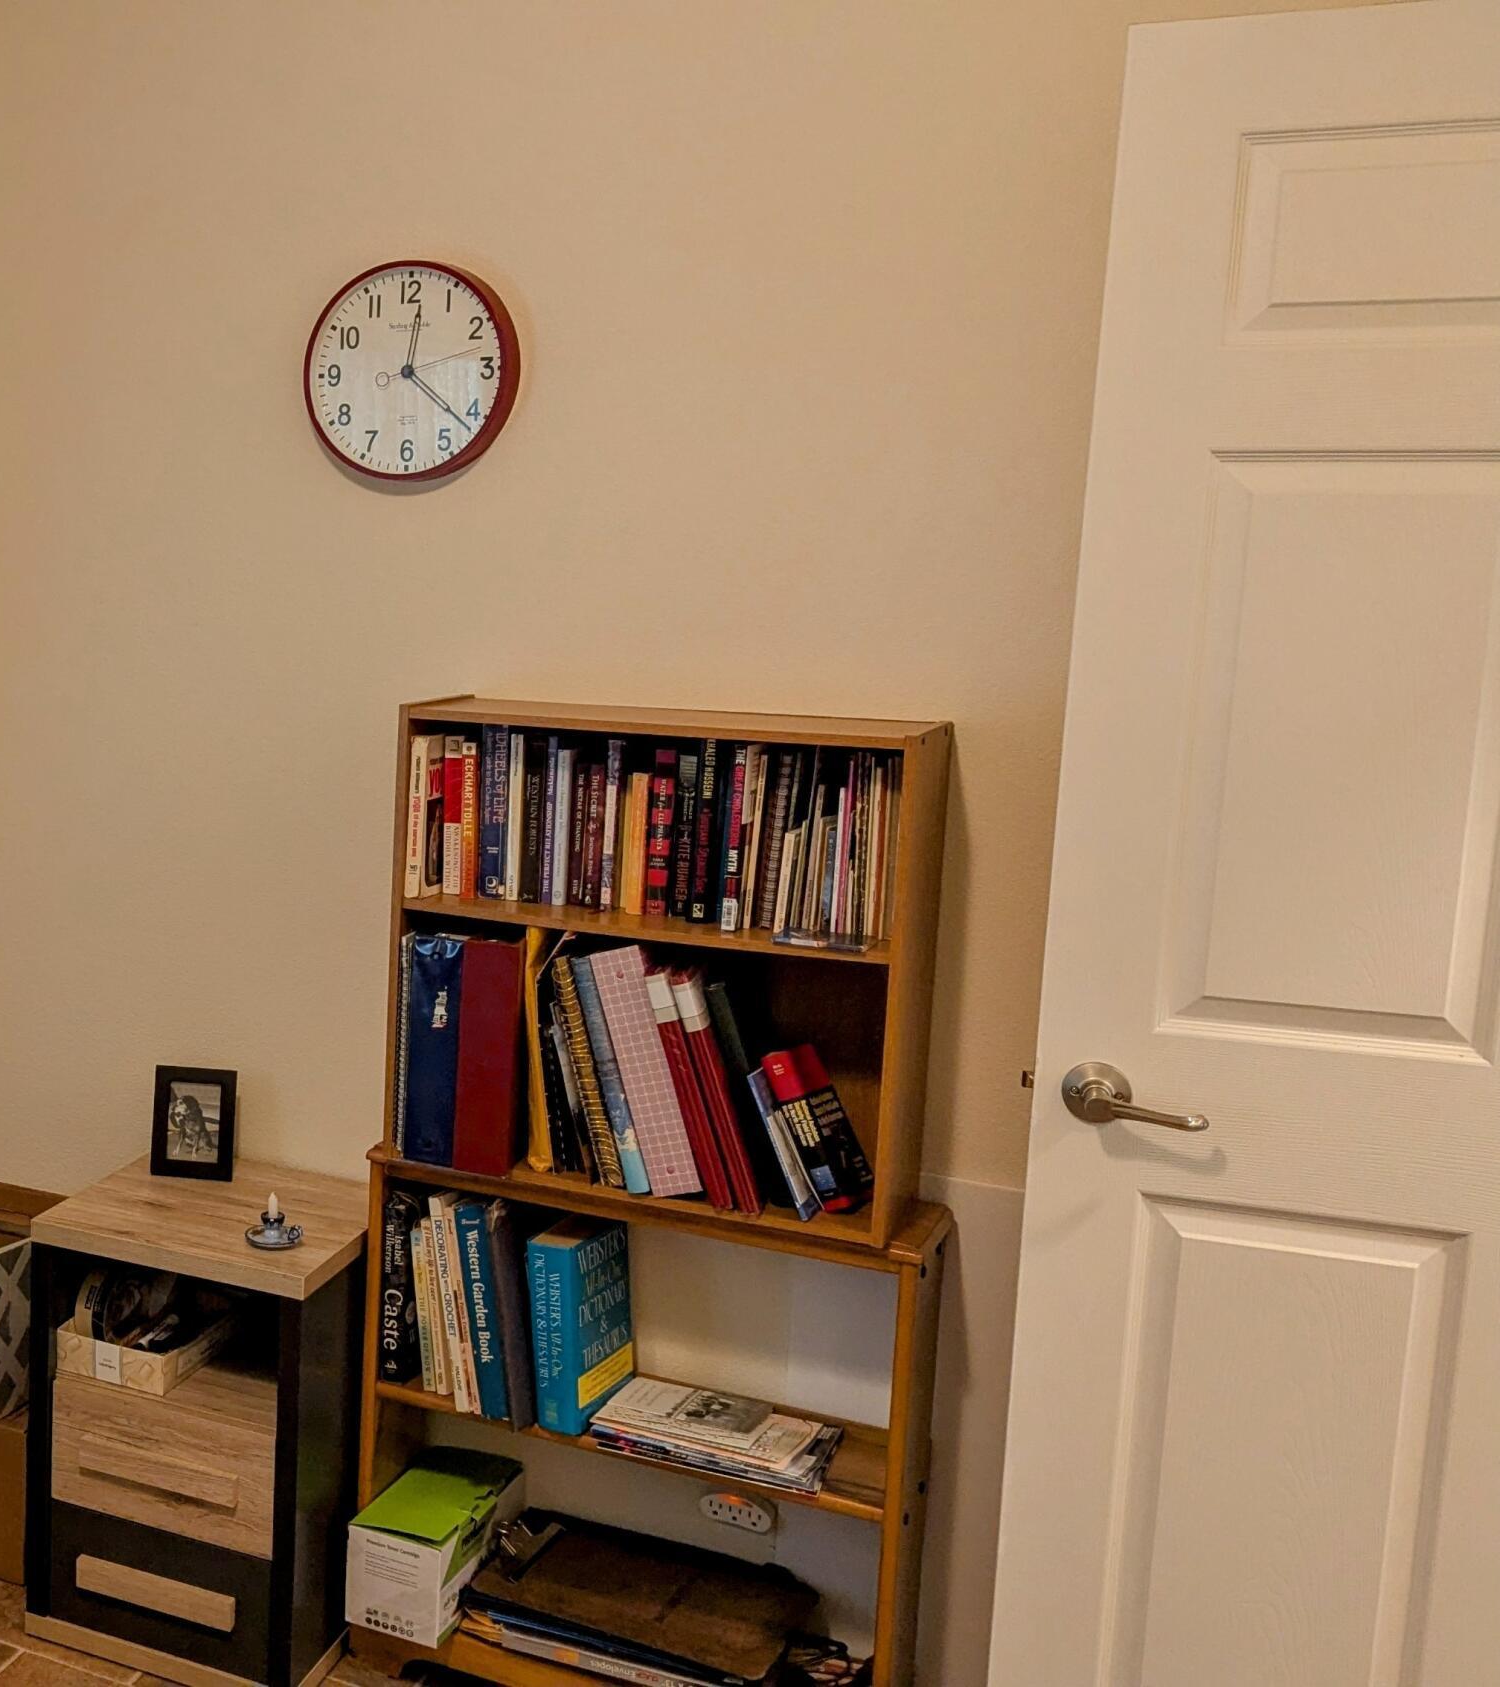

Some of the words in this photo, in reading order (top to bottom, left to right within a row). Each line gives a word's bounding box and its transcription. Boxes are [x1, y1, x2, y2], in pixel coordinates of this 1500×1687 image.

[369, 294, 381, 318] 11
[401, 280, 421, 304] 12
[446, 289, 451, 312] 1
[340, 326, 360, 350] 10
[468, 316, 483, 340] 2
[327, 364, 341, 387] 9
[480, 356, 494, 380] 3
[337, 403, 351, 426] 8
[466, 398, 481, 421] 4
[365, 430, 379, 452] 7
[400, 439, 414, 462] 6
[437, 428, 451, 451] 5
[495, 732, 506, 782] WHEELS
[735, 749, 746, 764] THE
[464, 758, 474, 804] ECKHART
[591, 775, 600, 789] THE
[702, 767, 715, 799] HOSSEINI
[733, 765, 744, 791] GREAT
[493, 797, 505, 824] LIFE
[530, 775, 540, 818] WESTERN
[589, 791, 598, 818] SECRET
[463, 807, 472, 837] TOLLE
[544, 802, 552, 849] RELATIONSHIP
[656, 812, 664, 850] ELEPHANTS
[729, 793, 742, 848] CHOLESTEROL
[529, 820, 539, 856] FORESTS
[678, 839, 691, 860] KITE
[727, 850, 738, 873] MYTH
[675, 862, 689, 901] RUNNER
[385, 1223, 395, 1273] Wilkerson
[394, 1235, 404, 1266] Isabel
[465, 1229, 481, 1279] Western
[577, 1225, 626, 1274] WEBSTER'S
[434, 1219, 450, 1278] DECORATING
[444, 1292, 456, 1338] CROCHET
[534, 1253, 547, 1316] DICTIONARY
[472, 1282, 488, 1328] Garden
[579, 1282, 626, 1328] DICTIONARY
[383, 1289, 404, 1351] Caste
[537, 1318, 547, 1331] &
[599, 1314, 608, 1334] &
[478, 1331, 494, 1363] Book
[538, 1331, 549, 1388] THESAURUS
[582, 1322, 628, 1369] THESAURUS
[589, 1659, 636, 1677] Envelopes
